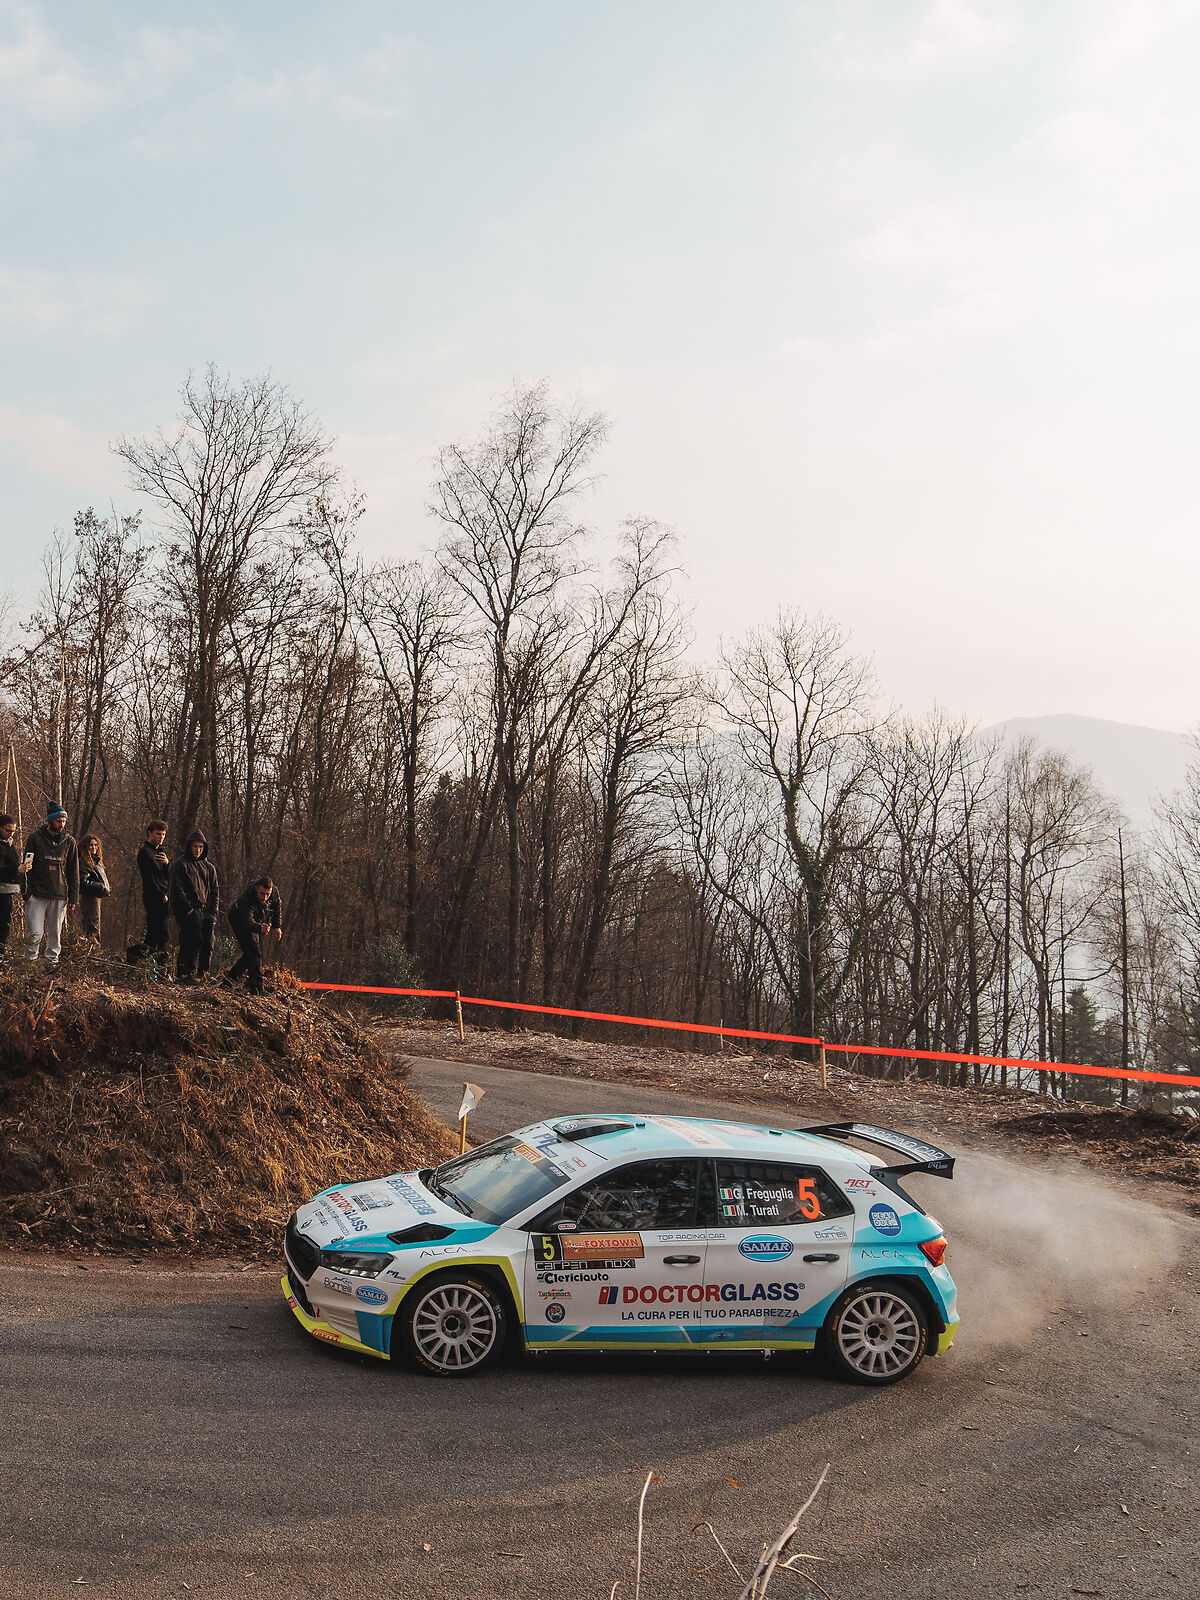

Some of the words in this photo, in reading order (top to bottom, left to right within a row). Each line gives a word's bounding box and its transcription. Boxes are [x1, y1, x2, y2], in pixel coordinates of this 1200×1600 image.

[733, 1188, 745, 1200] G.
[747, 1187, 794, 1202] Freguglia
[798, 1178, 820, 1220] 5
[736, 1206, 749, 1217] M.
[751, 1203, 780, 1217] Turati
[657, 1233, 674, 1241] TOP
[675, 1232, 707, 1241] RACING
[542, 1236, 555, 1260] 5
[584, 1239, 639, 1249] FOXTOWN
[742, 1242, 790, 1253] SAMAR
[357, 1289, 386, 1302] SAMAR
[621, 1312, 635, 1321] LA
[637, 1311, 666, 1320] CURA
[668, 1310, 690, 1320] PER
[692, 1310, 702, 1319] IL
[704, 1309, 727, 1319] TUO
[728, 1308, 800, 1319] PARABREZZA
